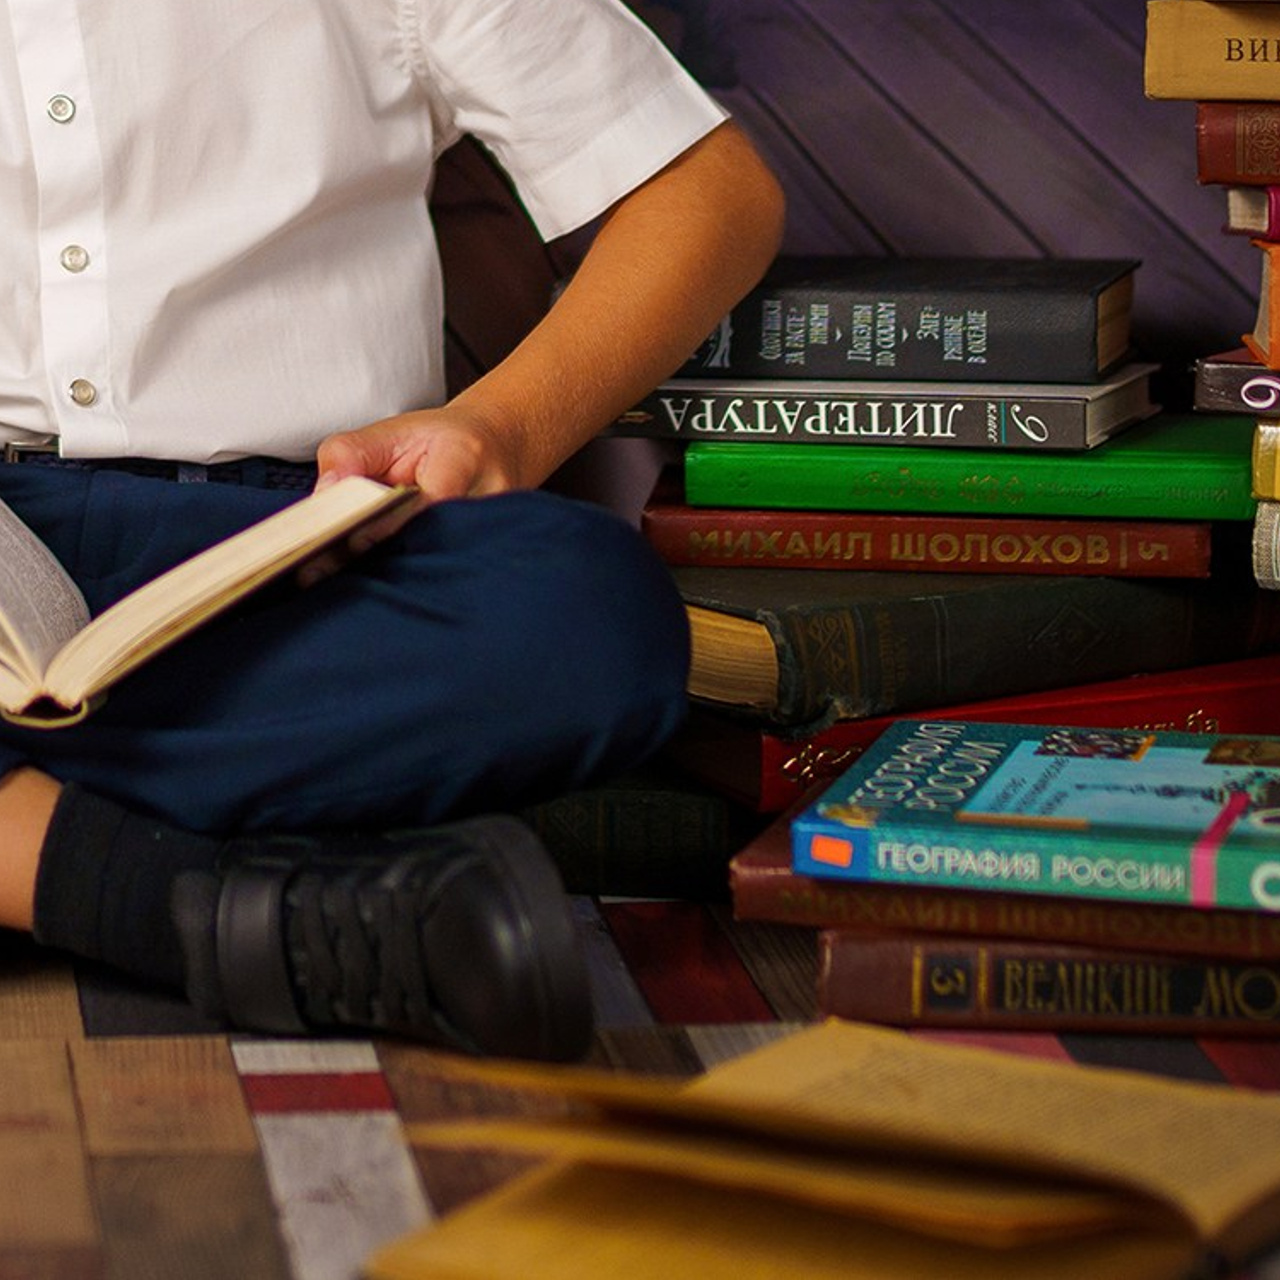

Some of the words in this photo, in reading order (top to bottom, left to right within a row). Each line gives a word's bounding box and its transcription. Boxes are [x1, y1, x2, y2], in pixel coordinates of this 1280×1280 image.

[661, 395, 964, 439] ЛИТЕРАТУРА
[688, 529, 872, 562] МИХАИЛ
[892, 530, 1109, 566] ШОЛОХОВ
[876, 841, 1041, 882] ГЕОГРАФИЯ
[1053, 855, 1186, 893] РОССИИ
